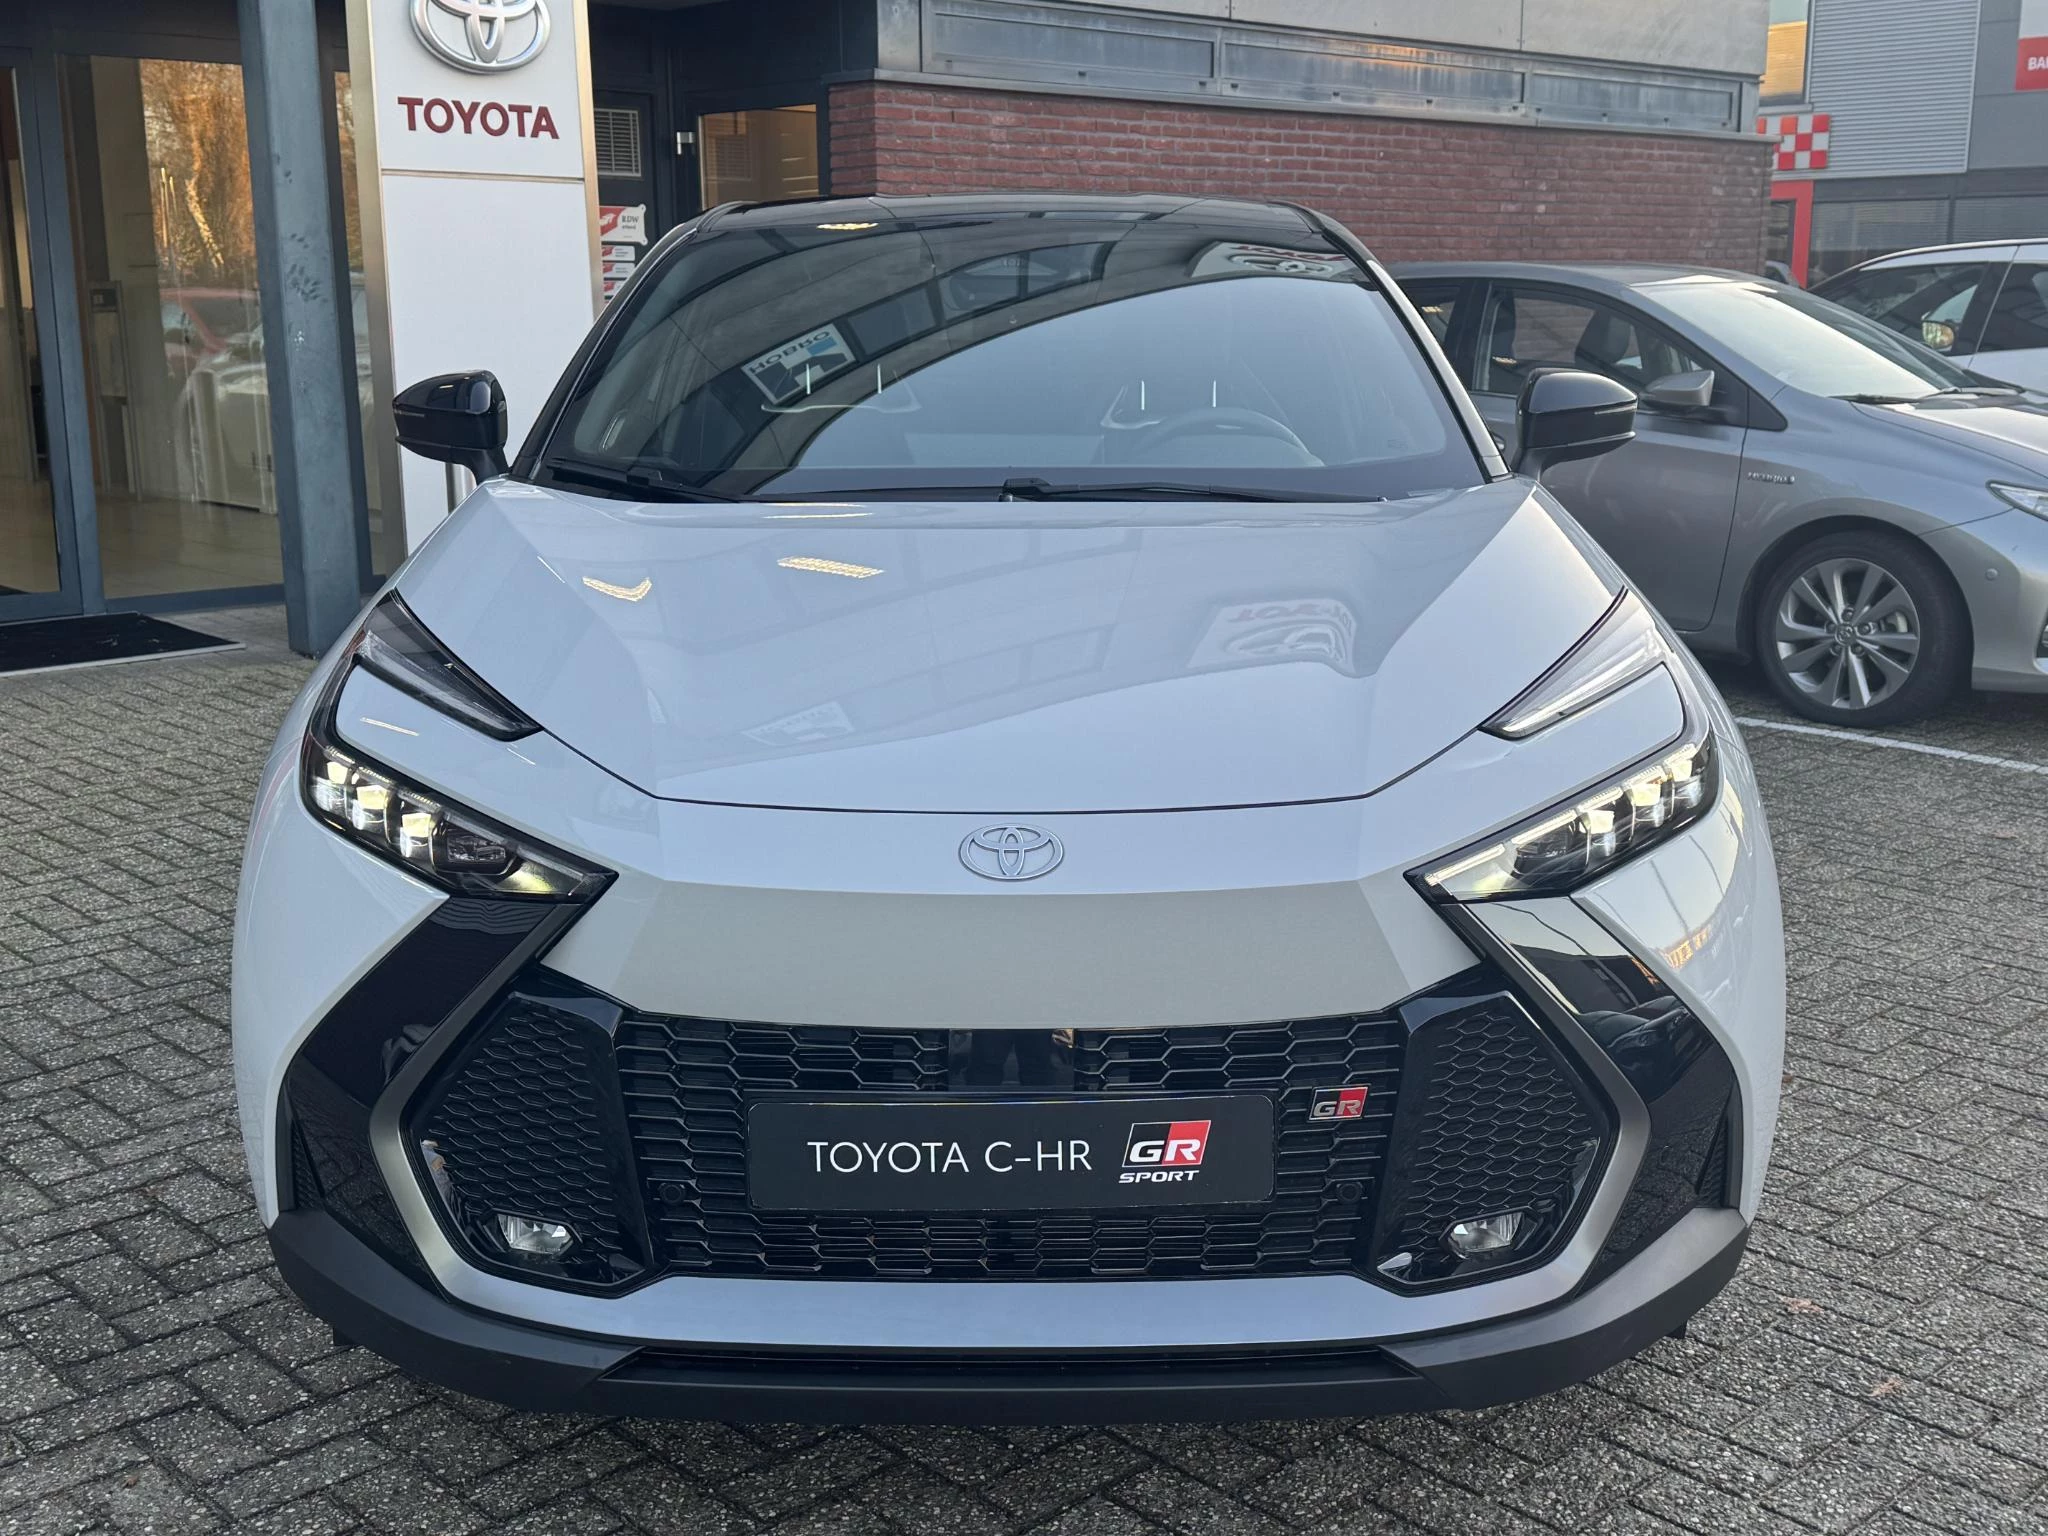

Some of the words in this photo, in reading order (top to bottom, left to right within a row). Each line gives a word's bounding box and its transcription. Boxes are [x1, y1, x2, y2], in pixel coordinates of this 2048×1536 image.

[397, 96, 560, 139] TOYOTA
[1313, 1100, 1361, 1117] GR
[807, 1141, 969, 1173] TOYOTA
[984, 1140, 1093, 1172] C-HR
[1129, 1139, 1201, 1163] GR
[1118, 1170, 1200, 1184] SPORT
